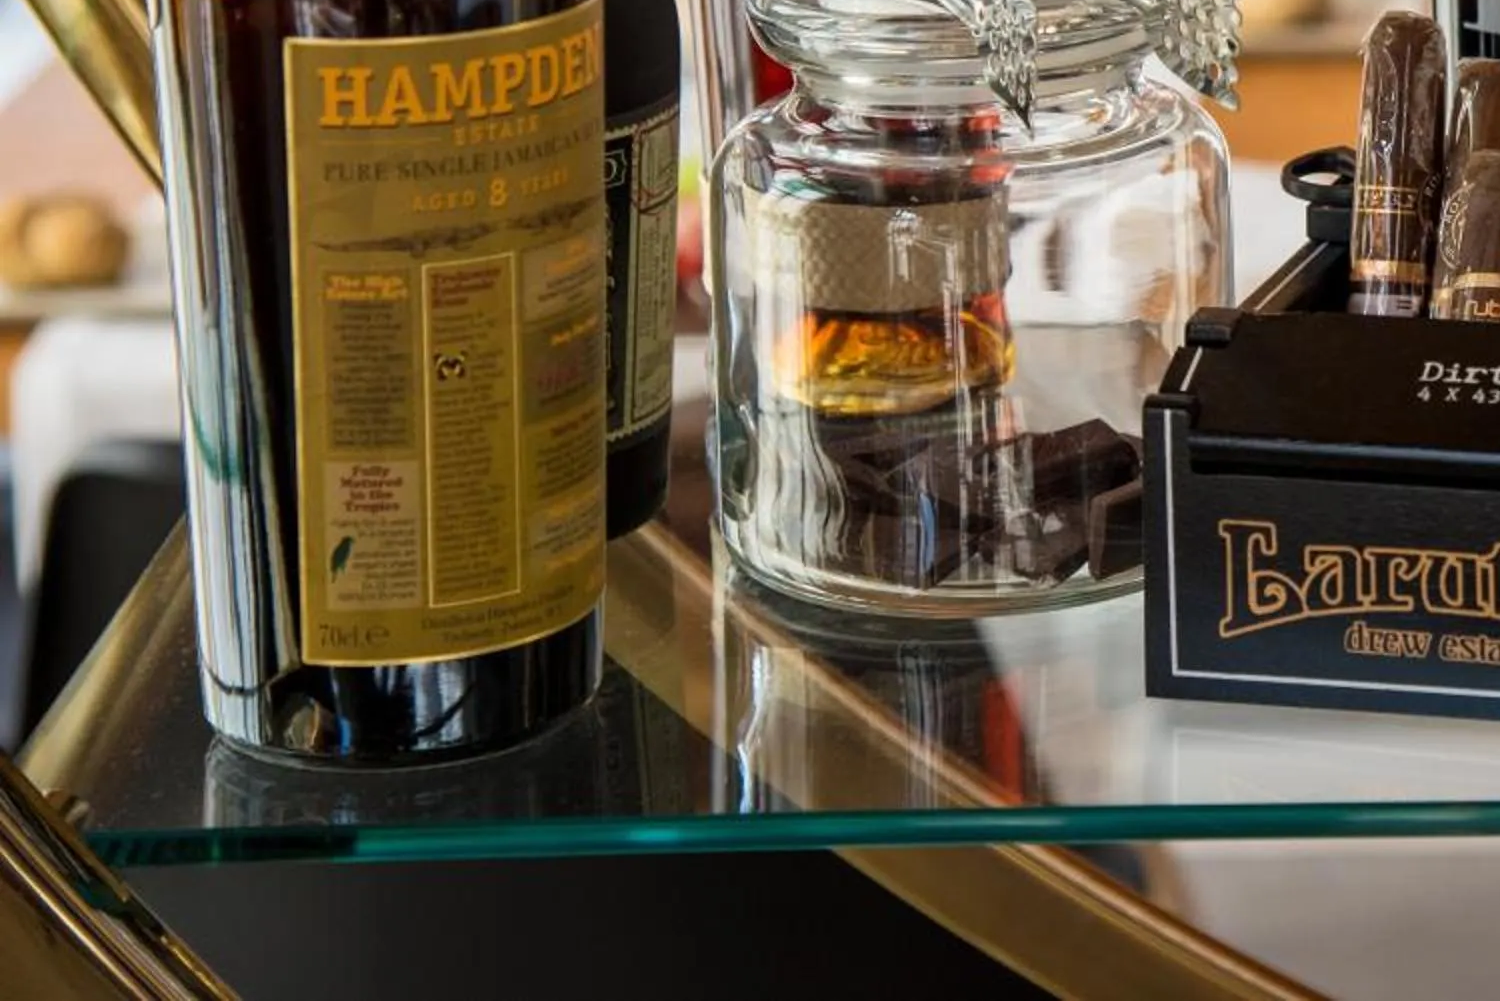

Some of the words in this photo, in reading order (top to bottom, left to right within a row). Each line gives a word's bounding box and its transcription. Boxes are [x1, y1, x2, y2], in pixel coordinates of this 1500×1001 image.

[323, 160, 391, 184] PURE
[396, 150, 489, 180] SINGLE
[412, 187, 477, 212] AGED
[487, 175, 509, 208] 8
[1416, 385, 1431, 402] 4
[1344, 620, 1433, 659] drew
